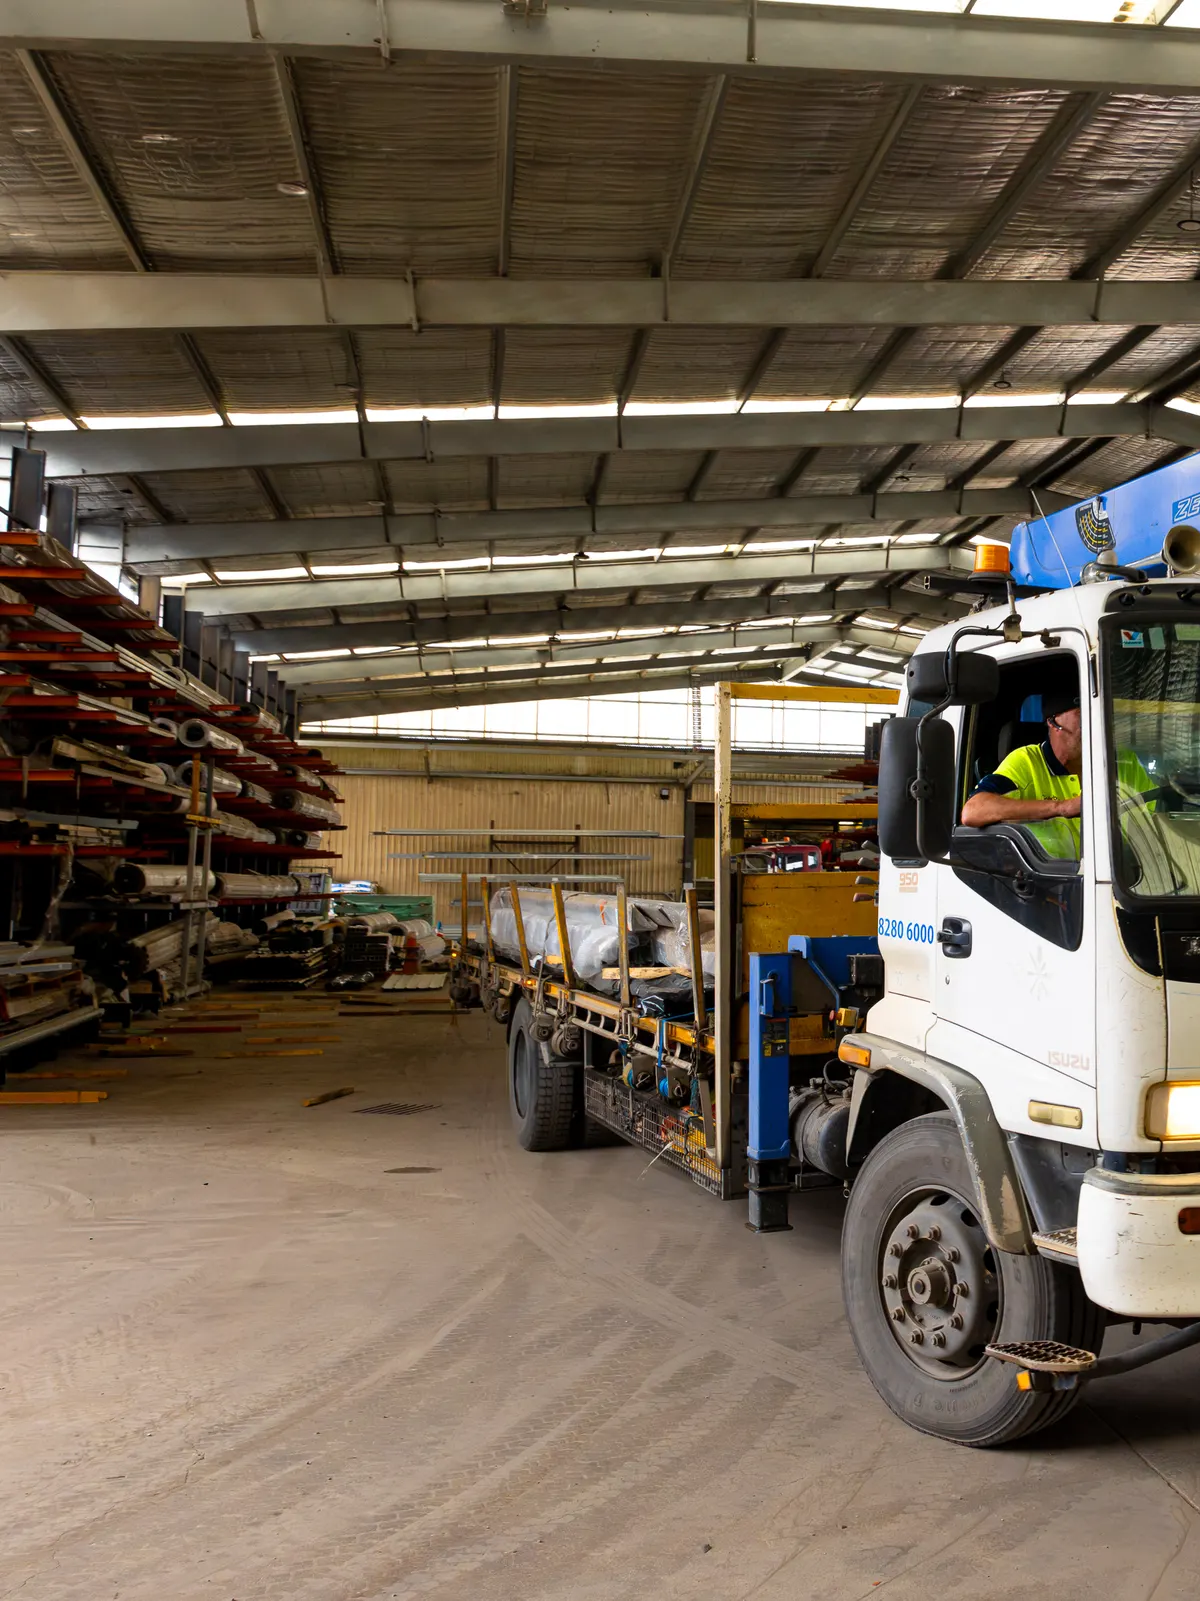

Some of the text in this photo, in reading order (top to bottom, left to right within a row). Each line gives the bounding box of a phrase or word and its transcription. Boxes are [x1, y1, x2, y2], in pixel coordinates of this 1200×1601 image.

[899, 872, 919, 886] 950
[878, 917, 935, 945] 8280 6000
[1048, 1050, 1090, 1071] ISUZU
